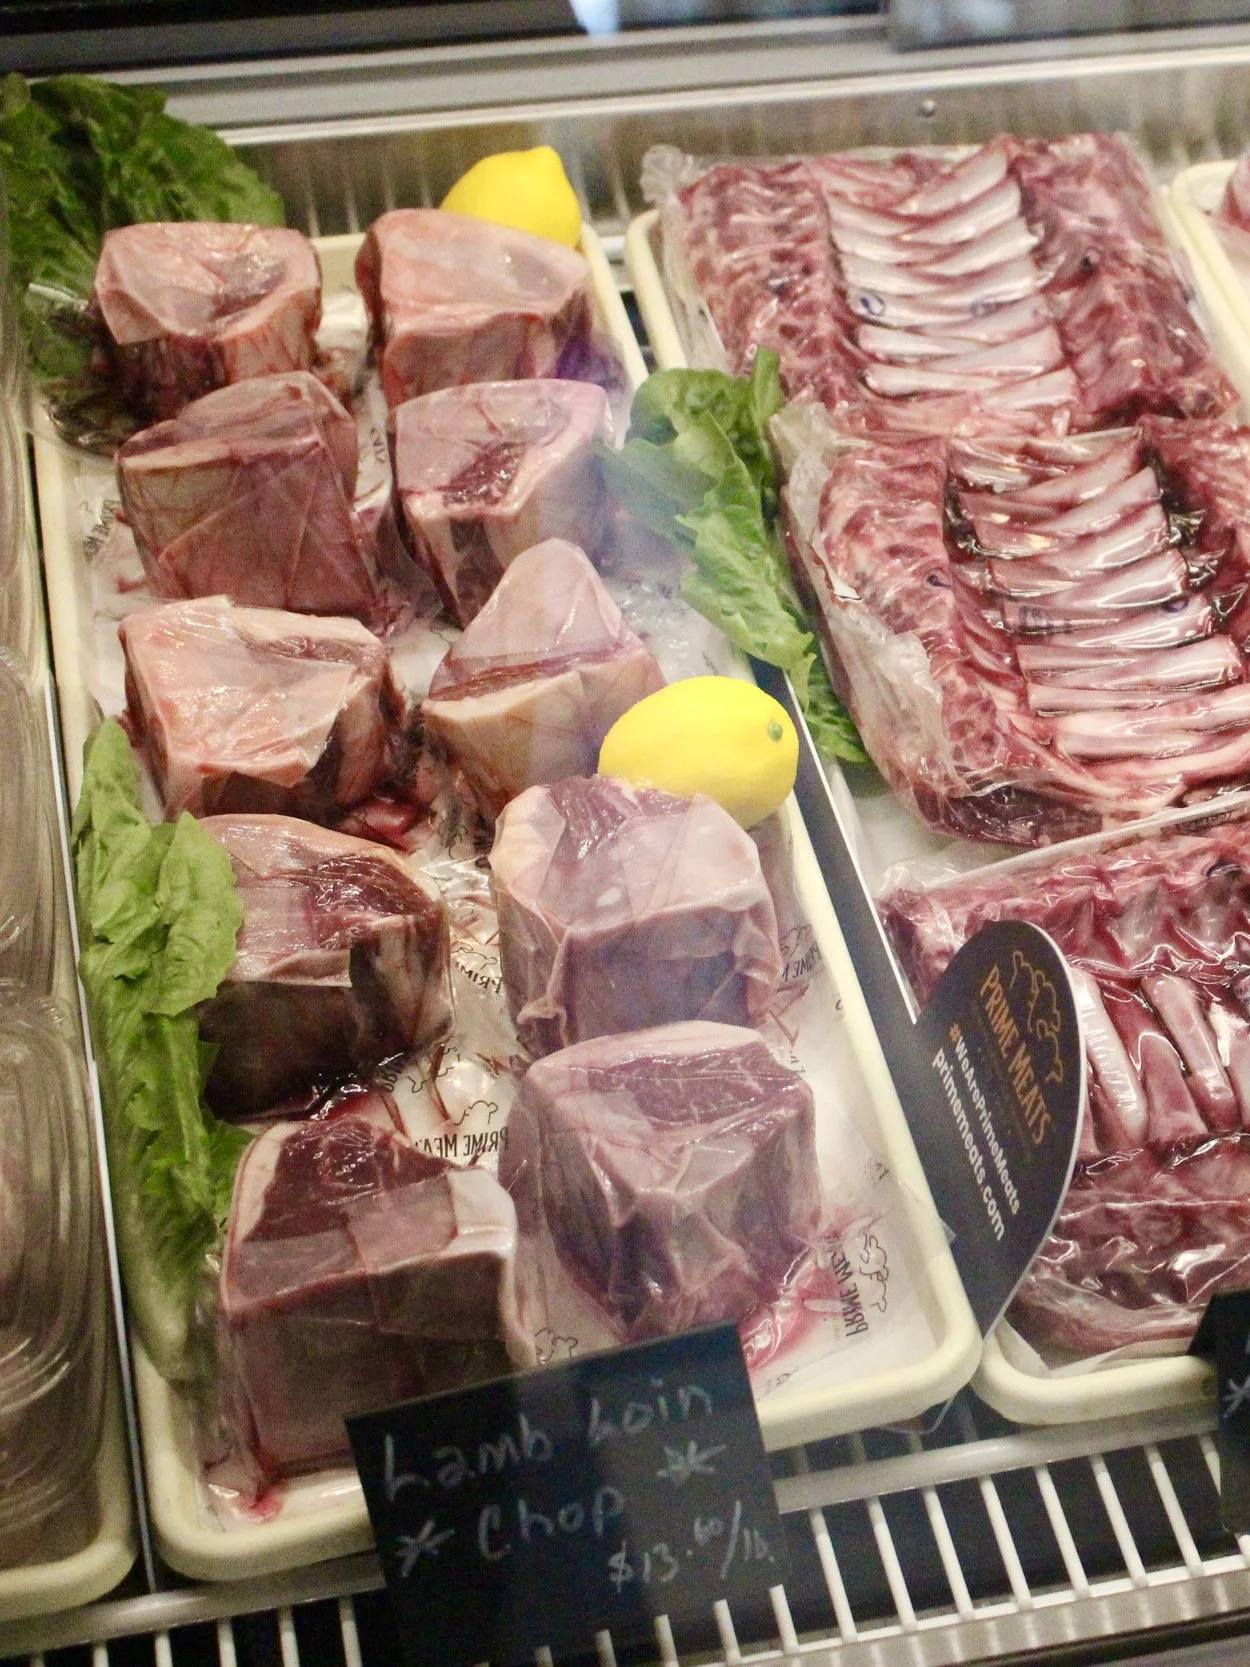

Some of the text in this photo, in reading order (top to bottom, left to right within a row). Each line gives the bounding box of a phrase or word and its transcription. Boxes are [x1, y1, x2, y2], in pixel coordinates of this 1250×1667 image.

[932, 1048, 1005, 1241] primemeats.com
[950, 1021, 1021, 1216] #WeArePrimeMeats
[980, 962, 1051, 1145] PRIME MEATS
[384, 1378, 713, 1503] Lamb Loin
[478, 1485, 626, 1563] Chop
